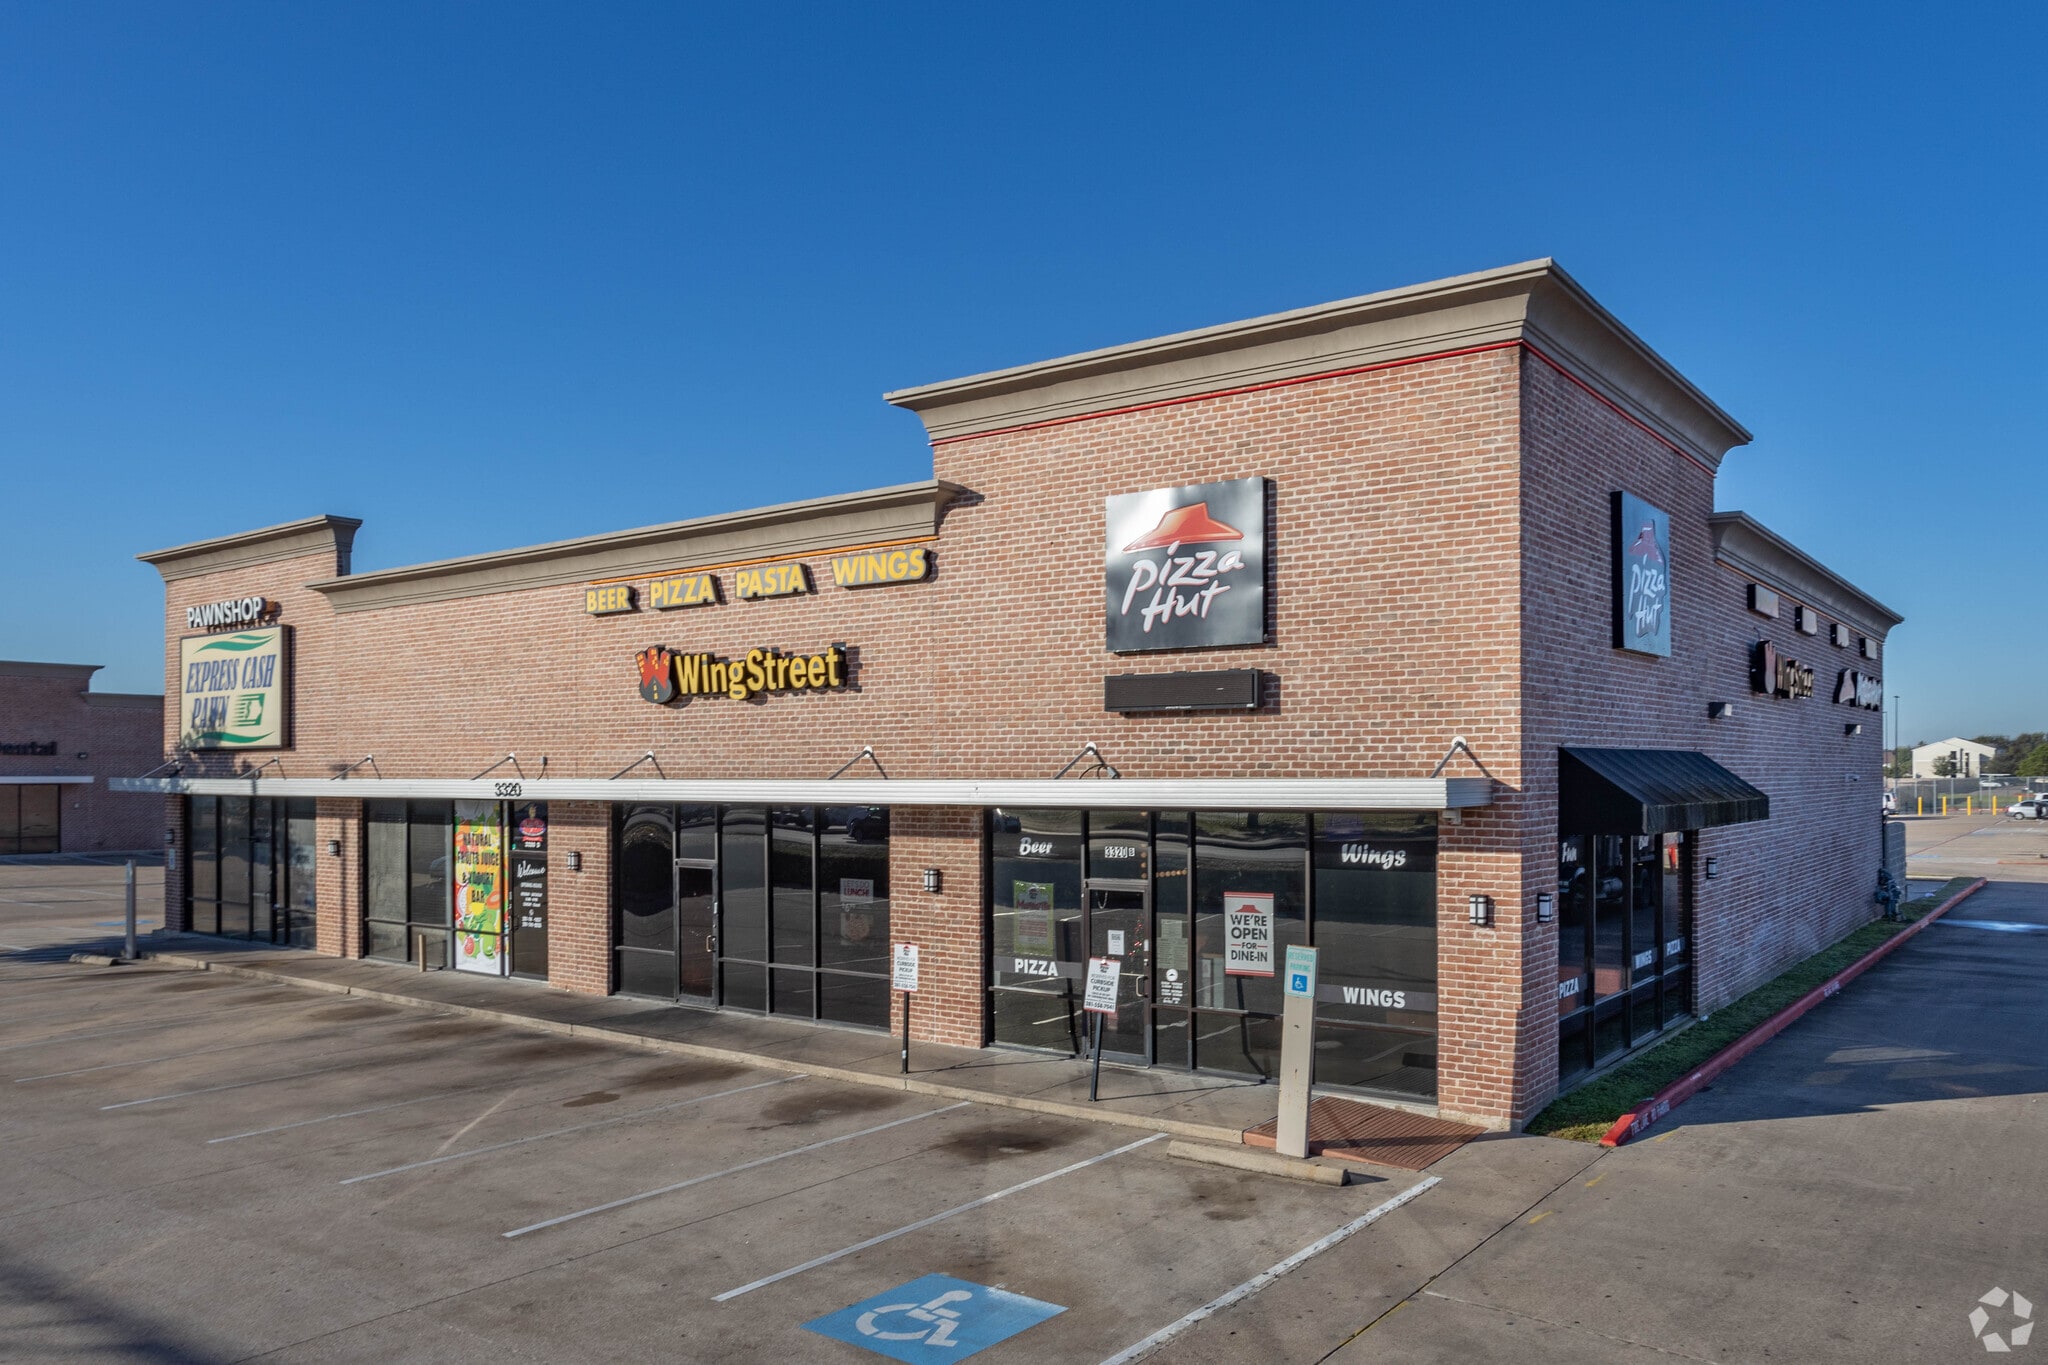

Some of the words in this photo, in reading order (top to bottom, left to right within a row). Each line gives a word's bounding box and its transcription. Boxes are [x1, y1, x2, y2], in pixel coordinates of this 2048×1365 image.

[831, 550, 926, 586] WINGS
[1121, 540, 1245, 616] Pizza
[651, 575, 715, 607] PIZZA
[736, 564, 805, 598] PASTA
[1628, 554, 1665, 614] Pizza
[586, 588, 630, 613] BEER
[1141, 580, 1231, 633] Hut
[186, 597, 262, 628] PAWNSHOP
[1635, 597, 1662, 635] Hut
[186, 658, 240, 693] EXPRESS
[242, 654, 277, 689] CASH
[675, 647, 840, 700] WingStreet
[191, 695, 230, 729] PAWN
[495, 783, 522, 797] 3320
[463, 832, 491, 846] NATURAL
[1019, 837, 1053, 856] Beer
[457, 851, 480, 866] FRUITS
[482, 852, 500, 866] JUICE
[1105, 846, 1128, 858] 3320
[1341, 843, 1407, 870] Wings
[516, 860, 546, 878] Welcome
[472, 890, 485, 903] BAR
[1230, 914, 1268, 927] WE'RE
[1231, 927, 1268, 941] OPEN
[1231, 949, 1268, 963] DINE-IN
[1241, 942, 1257, 950] FOR
[1014, 959, 1059, 976] PIZZA
[1342, 986, 1406, 1009] WINGS
[1559, 976, 1580, 999] PIZZA
